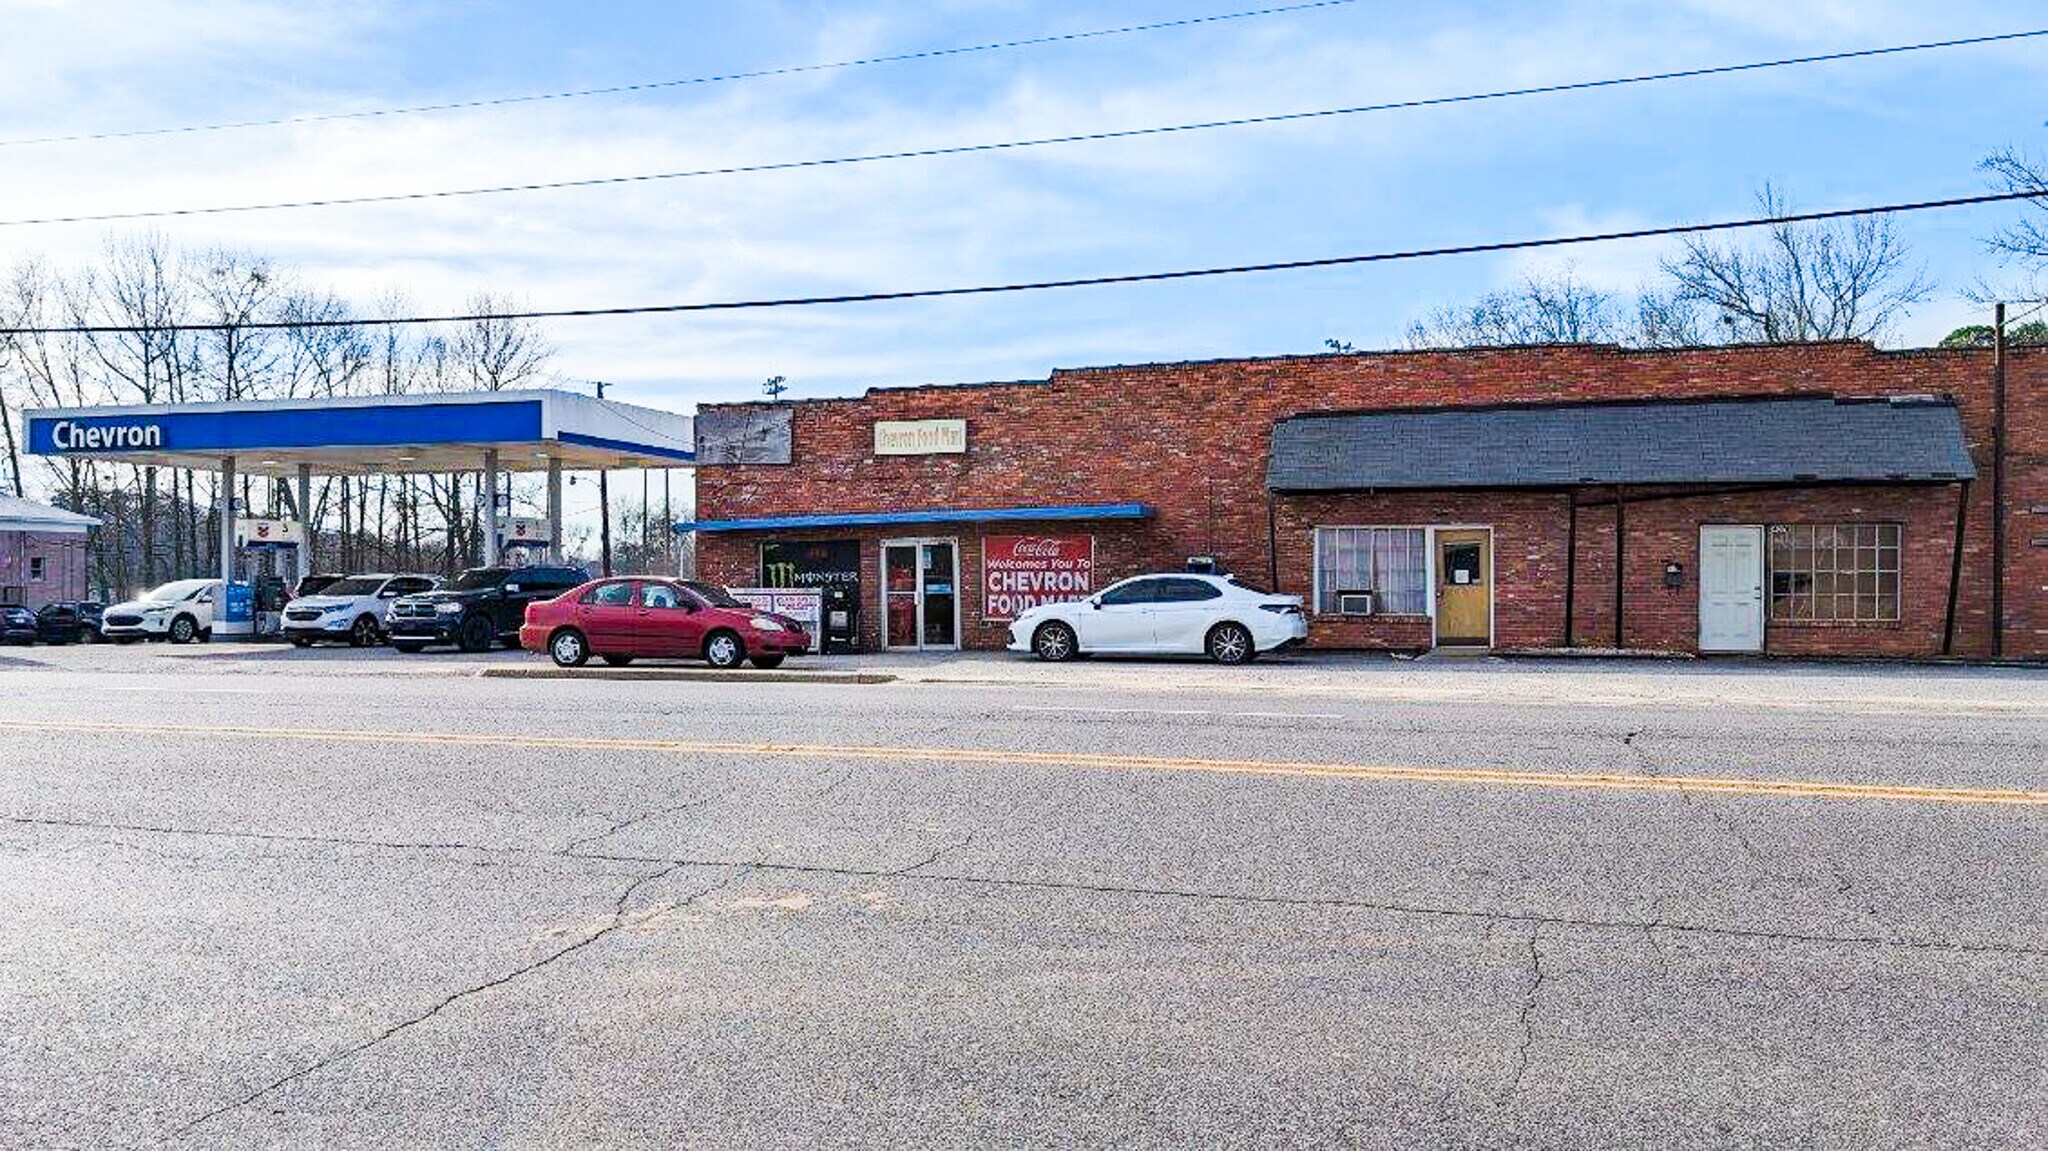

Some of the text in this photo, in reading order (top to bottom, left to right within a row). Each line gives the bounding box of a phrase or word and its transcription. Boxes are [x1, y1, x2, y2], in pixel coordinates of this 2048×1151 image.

[52, 421, 160, 449] Chevron
[987, 559, 1091, 570] Welcomes You To
[794, 571, 859, 584] MONSTER
[988, 571, 1090, 592] CHEVRON
